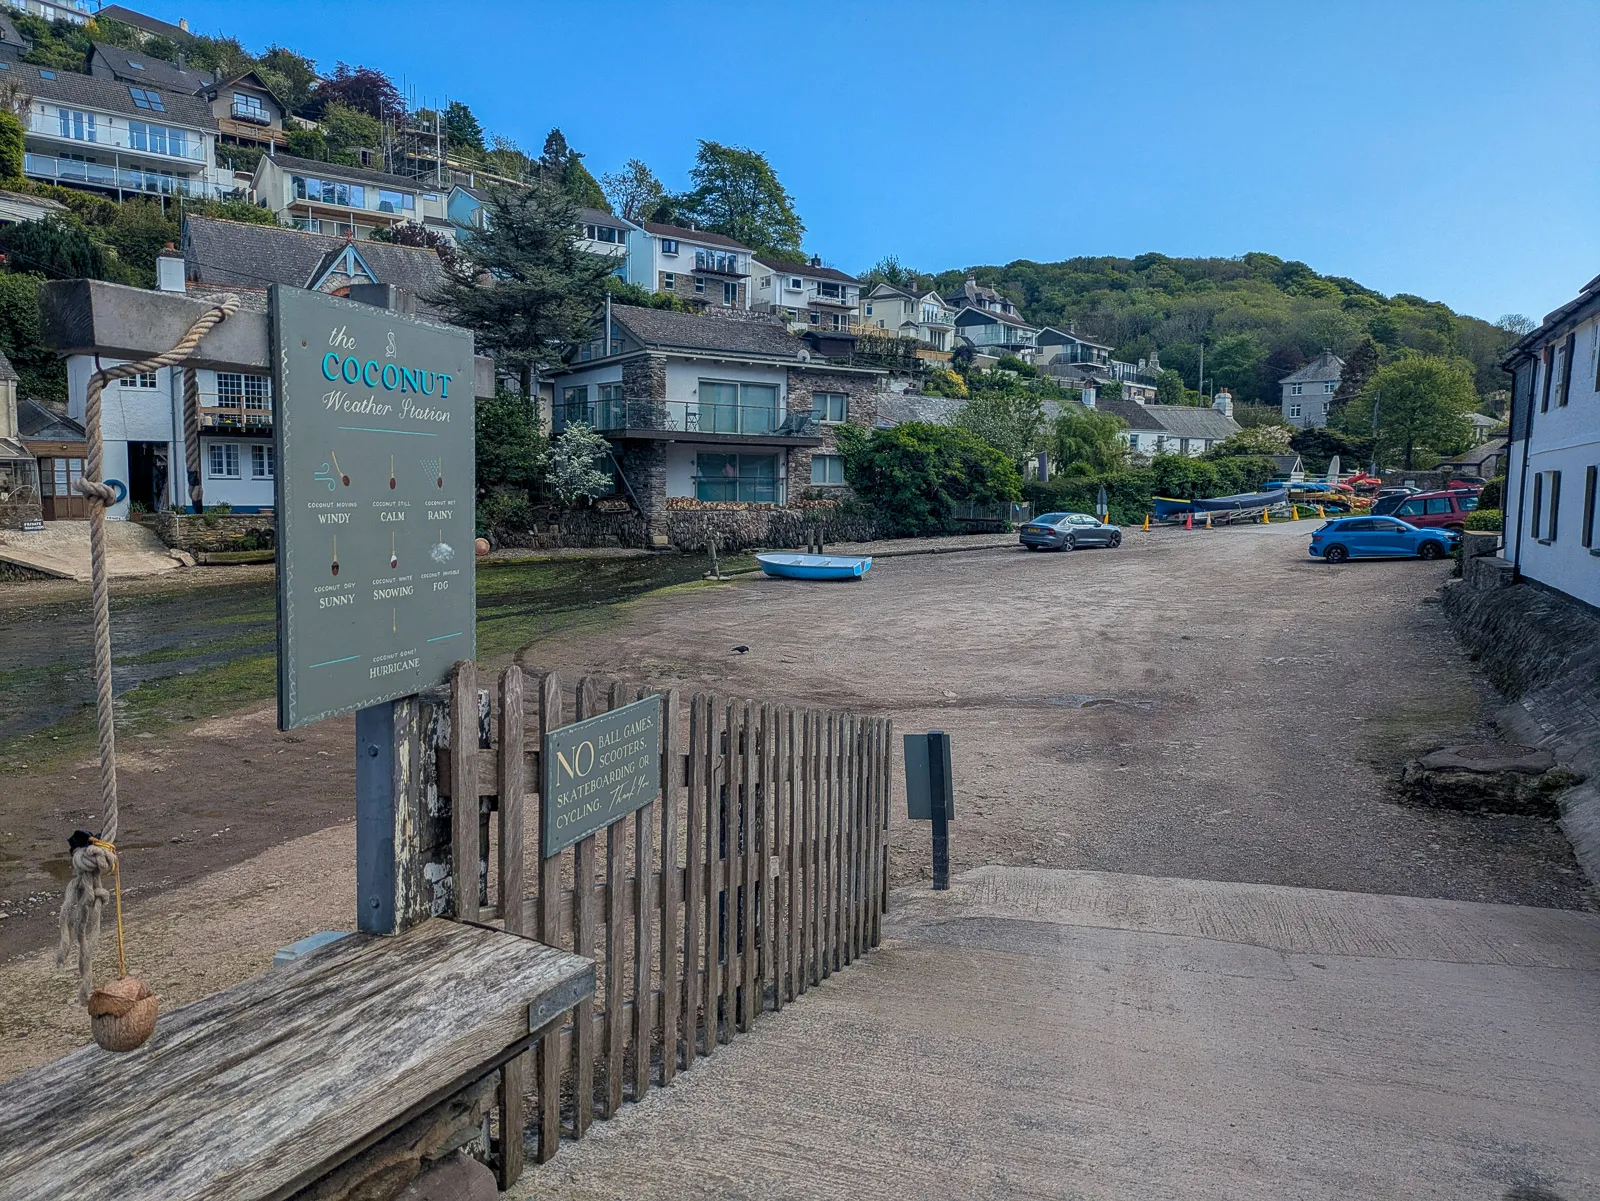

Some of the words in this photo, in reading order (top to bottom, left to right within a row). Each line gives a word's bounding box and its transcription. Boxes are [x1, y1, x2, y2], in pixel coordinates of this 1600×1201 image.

[329, 325, 357, 350] the
[322, 351, 452, 399] COCONUT
[323, 389, 392, 416] Weather
[399, 398, 451, 423] Station
[318, 512, 351, 524] WINDY
[380, 511, 405, 522] CALM
[427, 510, 453, 520] RAINY
[372, 577, 396, 585] COCONUT
[420, 571, 441, 579] COCONUT
[313, 584, 340, 593] COCONUT
[373, 585, 414, 601] SNOWING
[433, 580, 449, 592] FOG
[319, 593, 356, 609] SUNNY
[372, 652, 398, 663] COCONUT
[369, 657, 420, 679] HURRICANE
[598, 729, 621, 749] BALL
[556, 740, 595, 787] NO
[557, 761, 635, 808] SKATEBOARDING
[638, 754, 649, 769] OR
